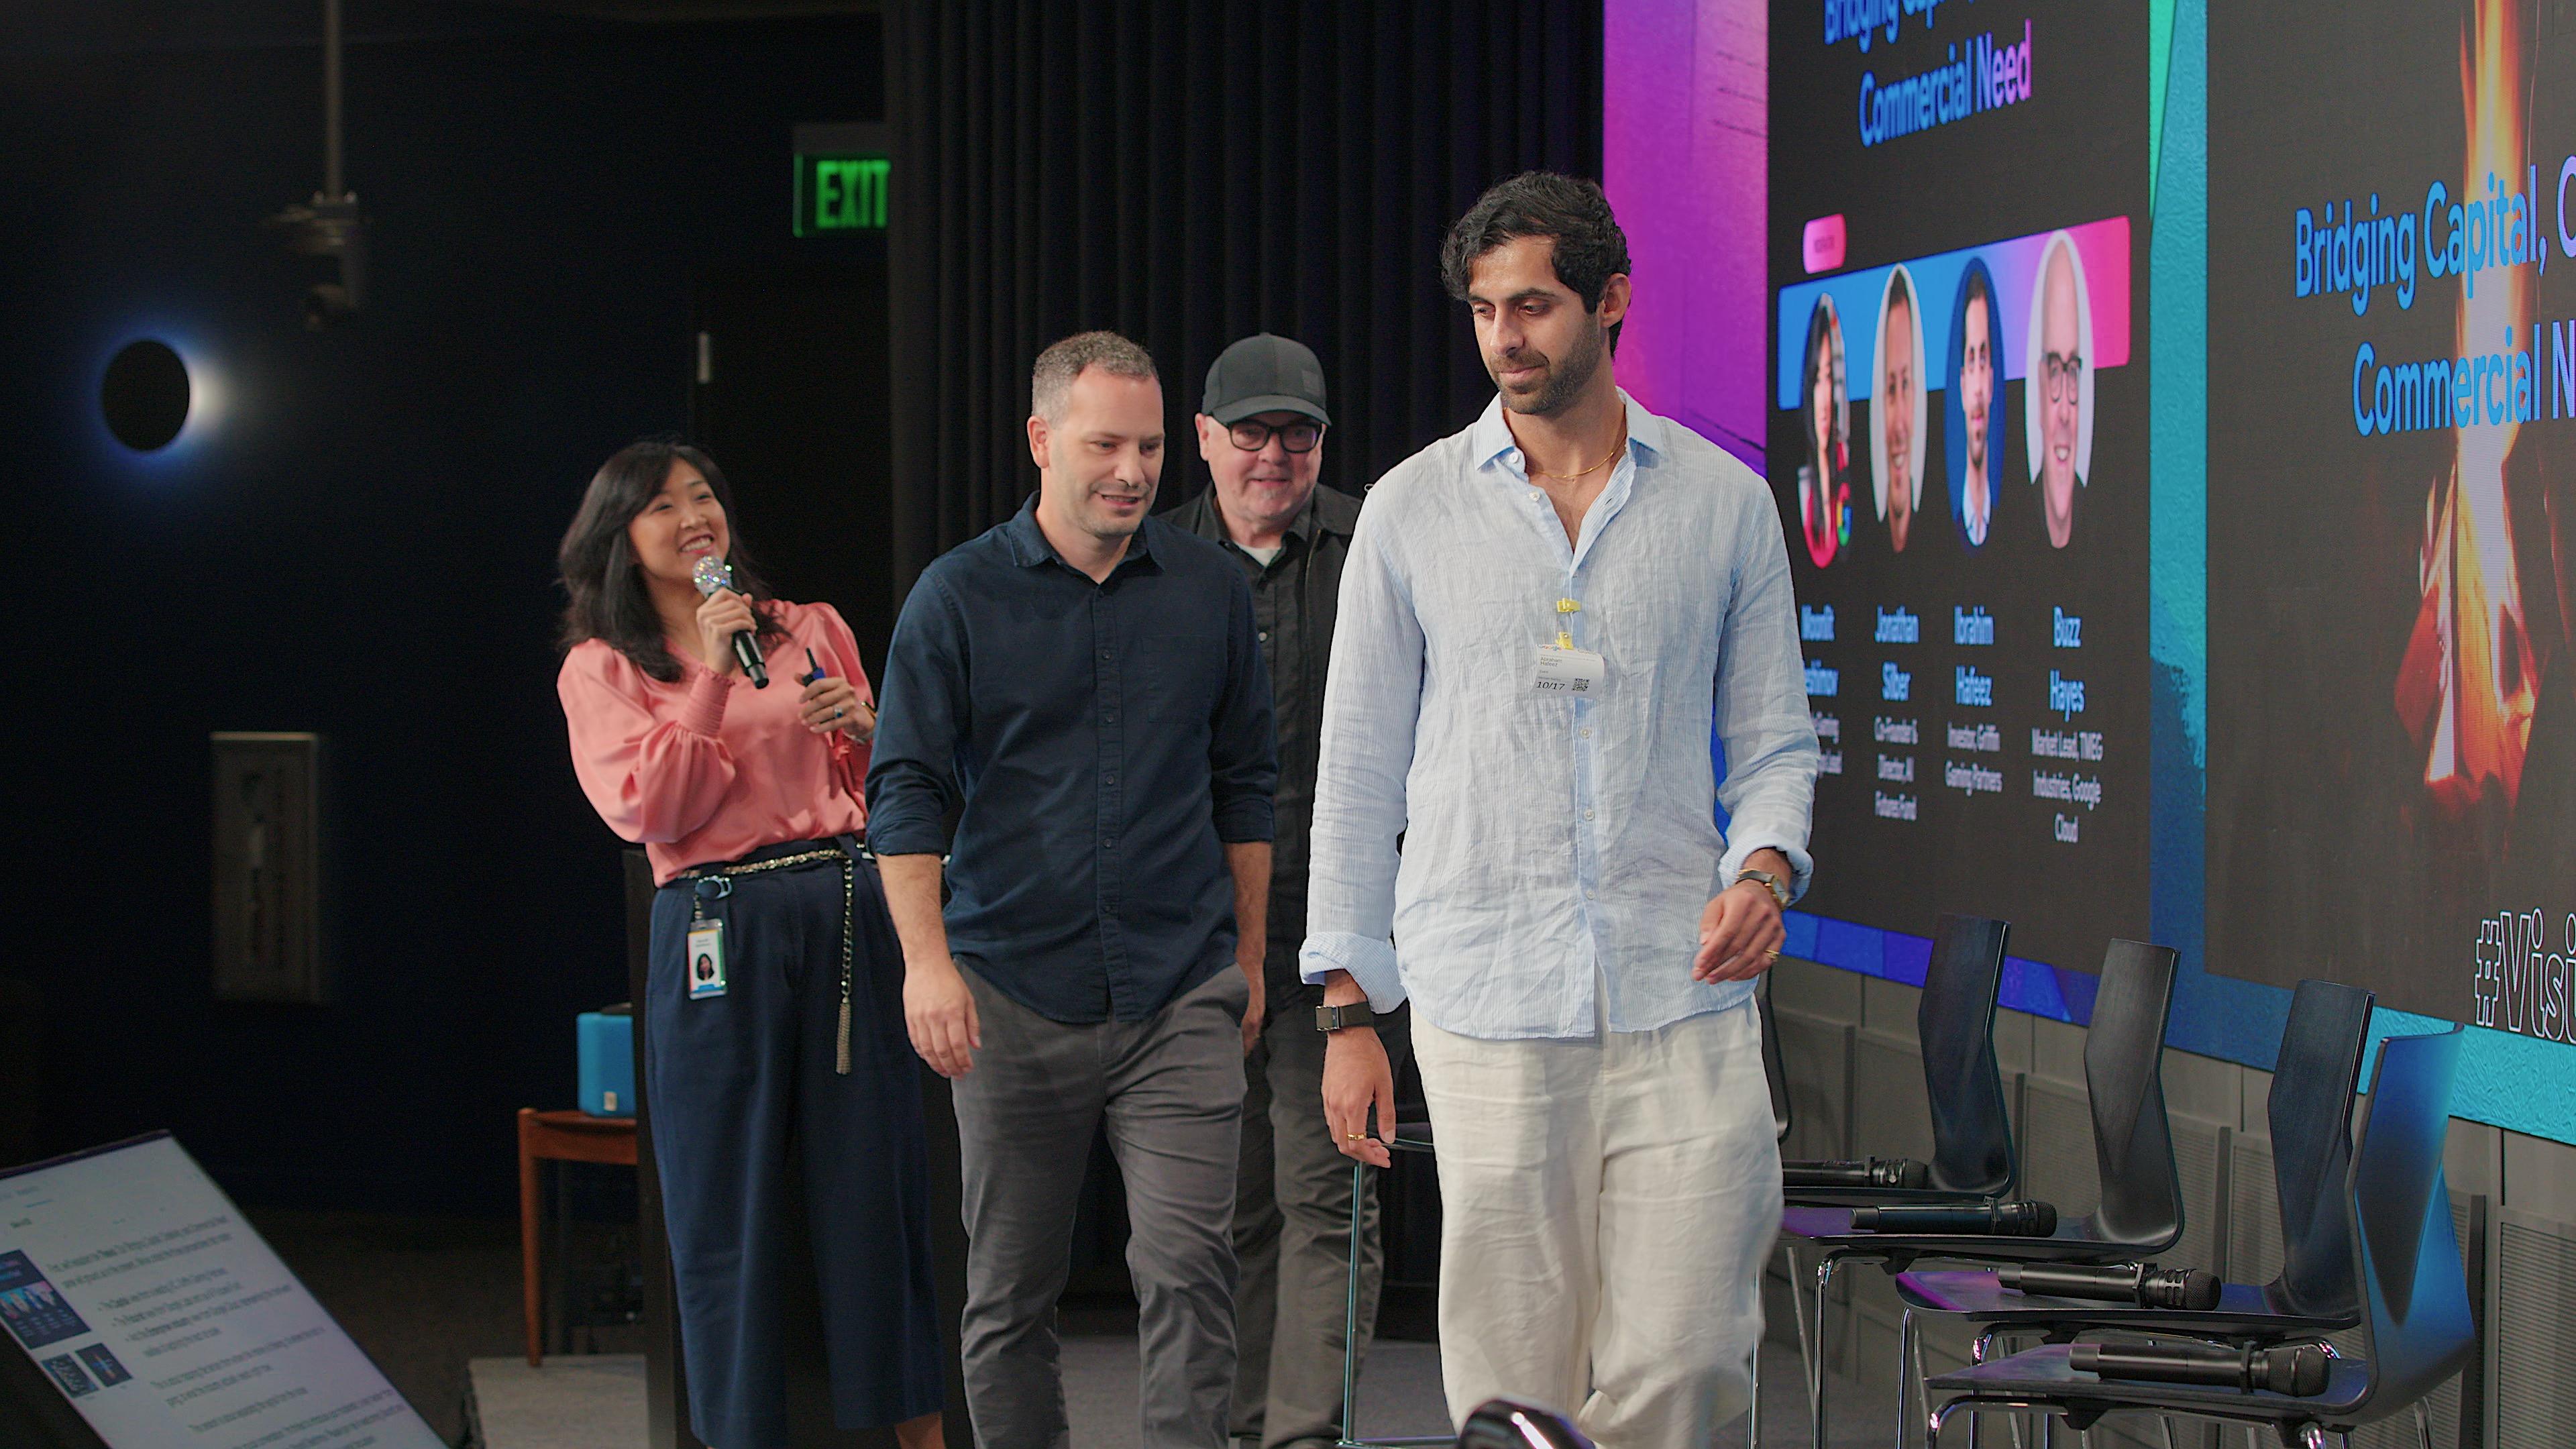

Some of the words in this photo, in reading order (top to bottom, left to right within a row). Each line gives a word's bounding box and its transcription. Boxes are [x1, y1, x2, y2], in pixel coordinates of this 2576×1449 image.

[1858, 37, 1973, 148] Commercial
[1976, 17, 2032, 113] Need
[816, 160, 892, 229] EXIT
[2296, 193, 2416, 317] Bridging
[2424, 164, 2548, 299] Capital,
[2353, 322, 2541, 437] Commercial
[1874, 605, 1921, 644] Jonathan
[1954, 605, 1994, 645] Ibrahim
[2053, 606, 2082, 648] Buzz
[1536, 681, 1565, 690] 10/17
[1955, 665, 1992, 706] Hafeez
[2049, 669, 2085, 722] Hayes
[2032, 728, 2058, 757] Market
[2059, 730, 2079, 762] Lead,
[2033, 769, 2072, 803] Industries,
[2072, 773, 2102, 810] Google
[2055, 812, 2078, 843] Cloud
